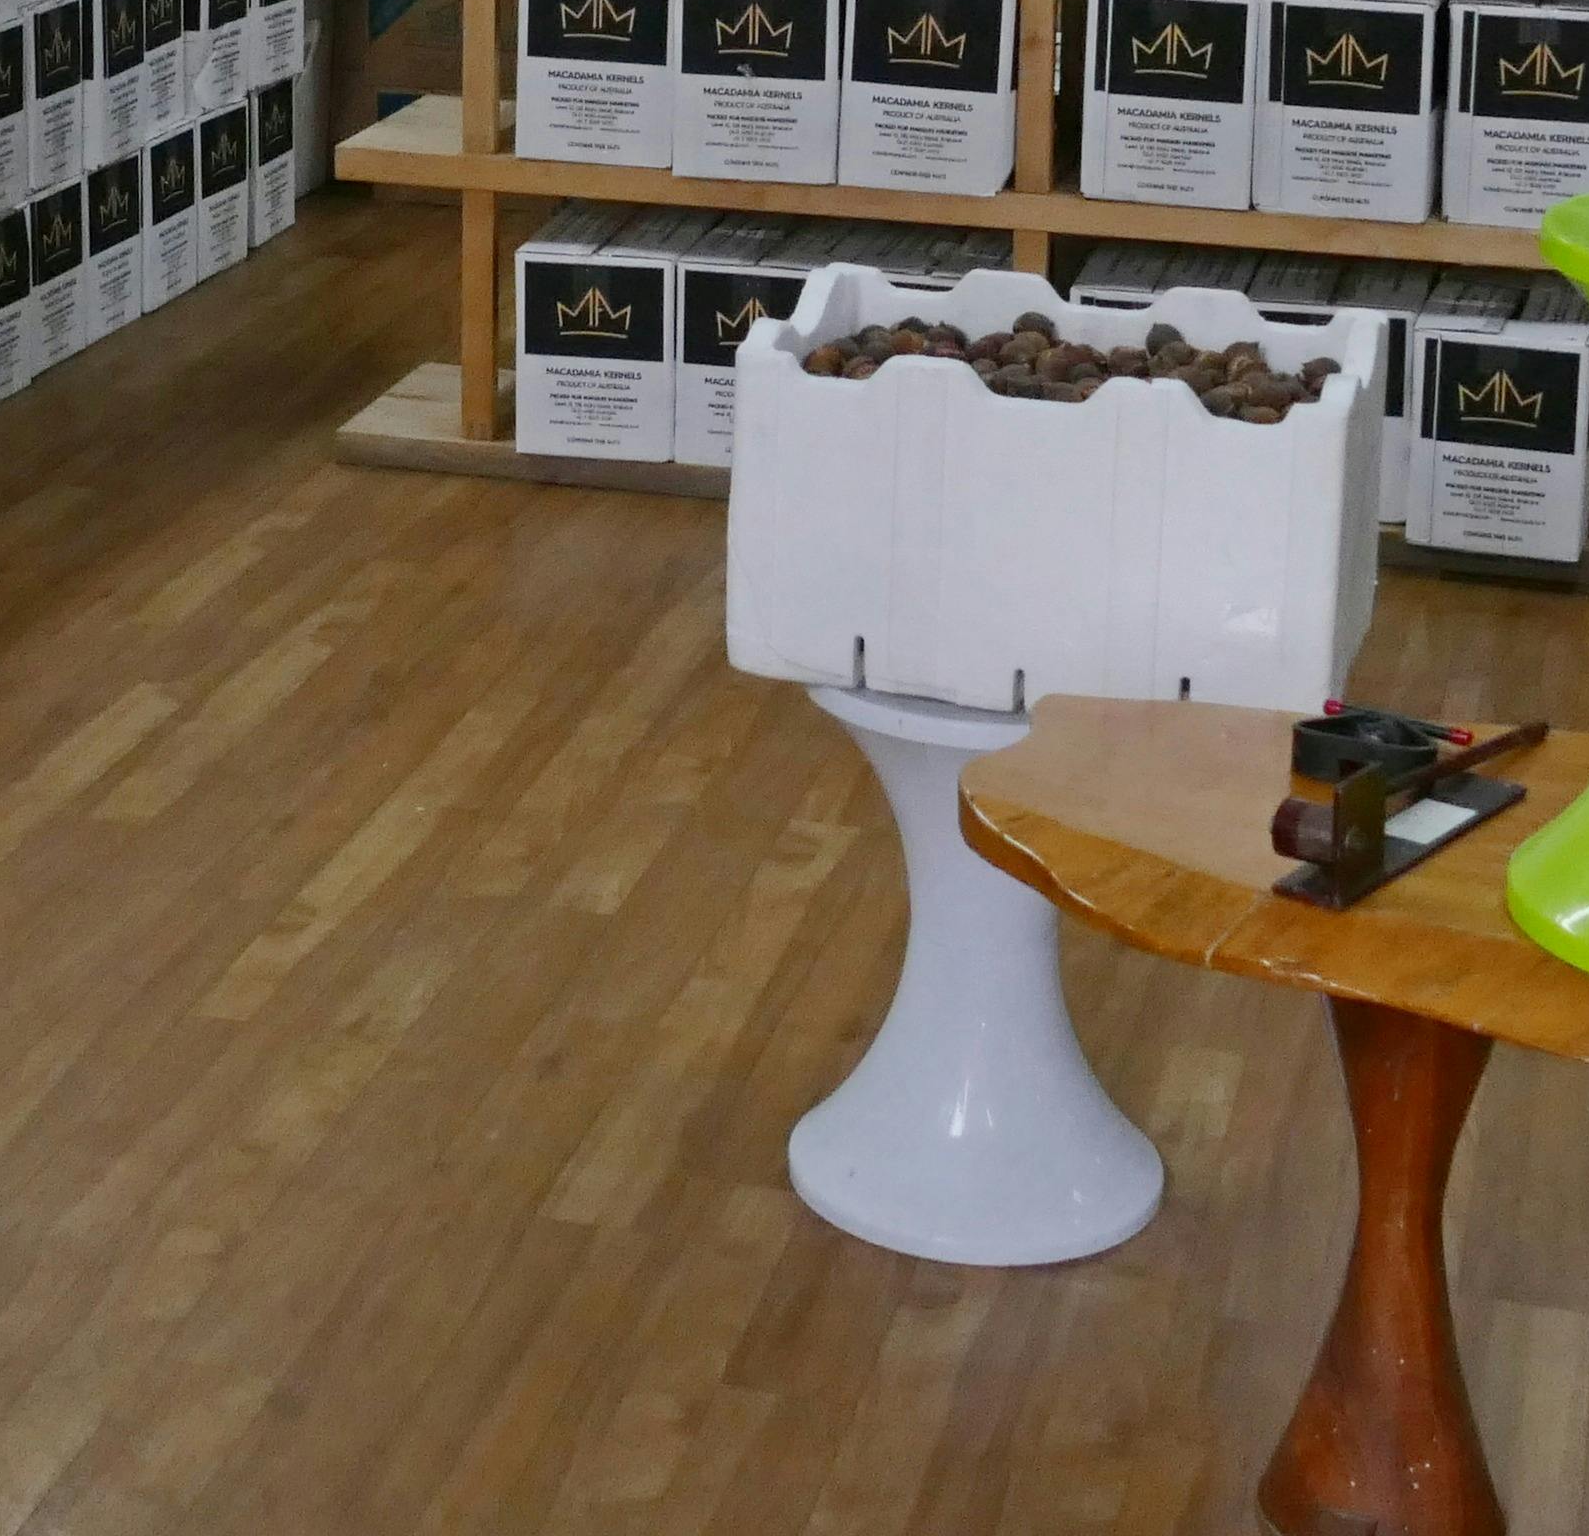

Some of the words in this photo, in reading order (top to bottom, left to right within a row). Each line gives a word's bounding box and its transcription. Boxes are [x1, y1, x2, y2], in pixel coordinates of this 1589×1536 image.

[547, 69, 604, 83] MACADAMIA
[605, 73, 645, 85] KERNELS
[1116, 106, 1177, 120] MACADAMIA
[1179, 111, 1222, 124] KERNELS
